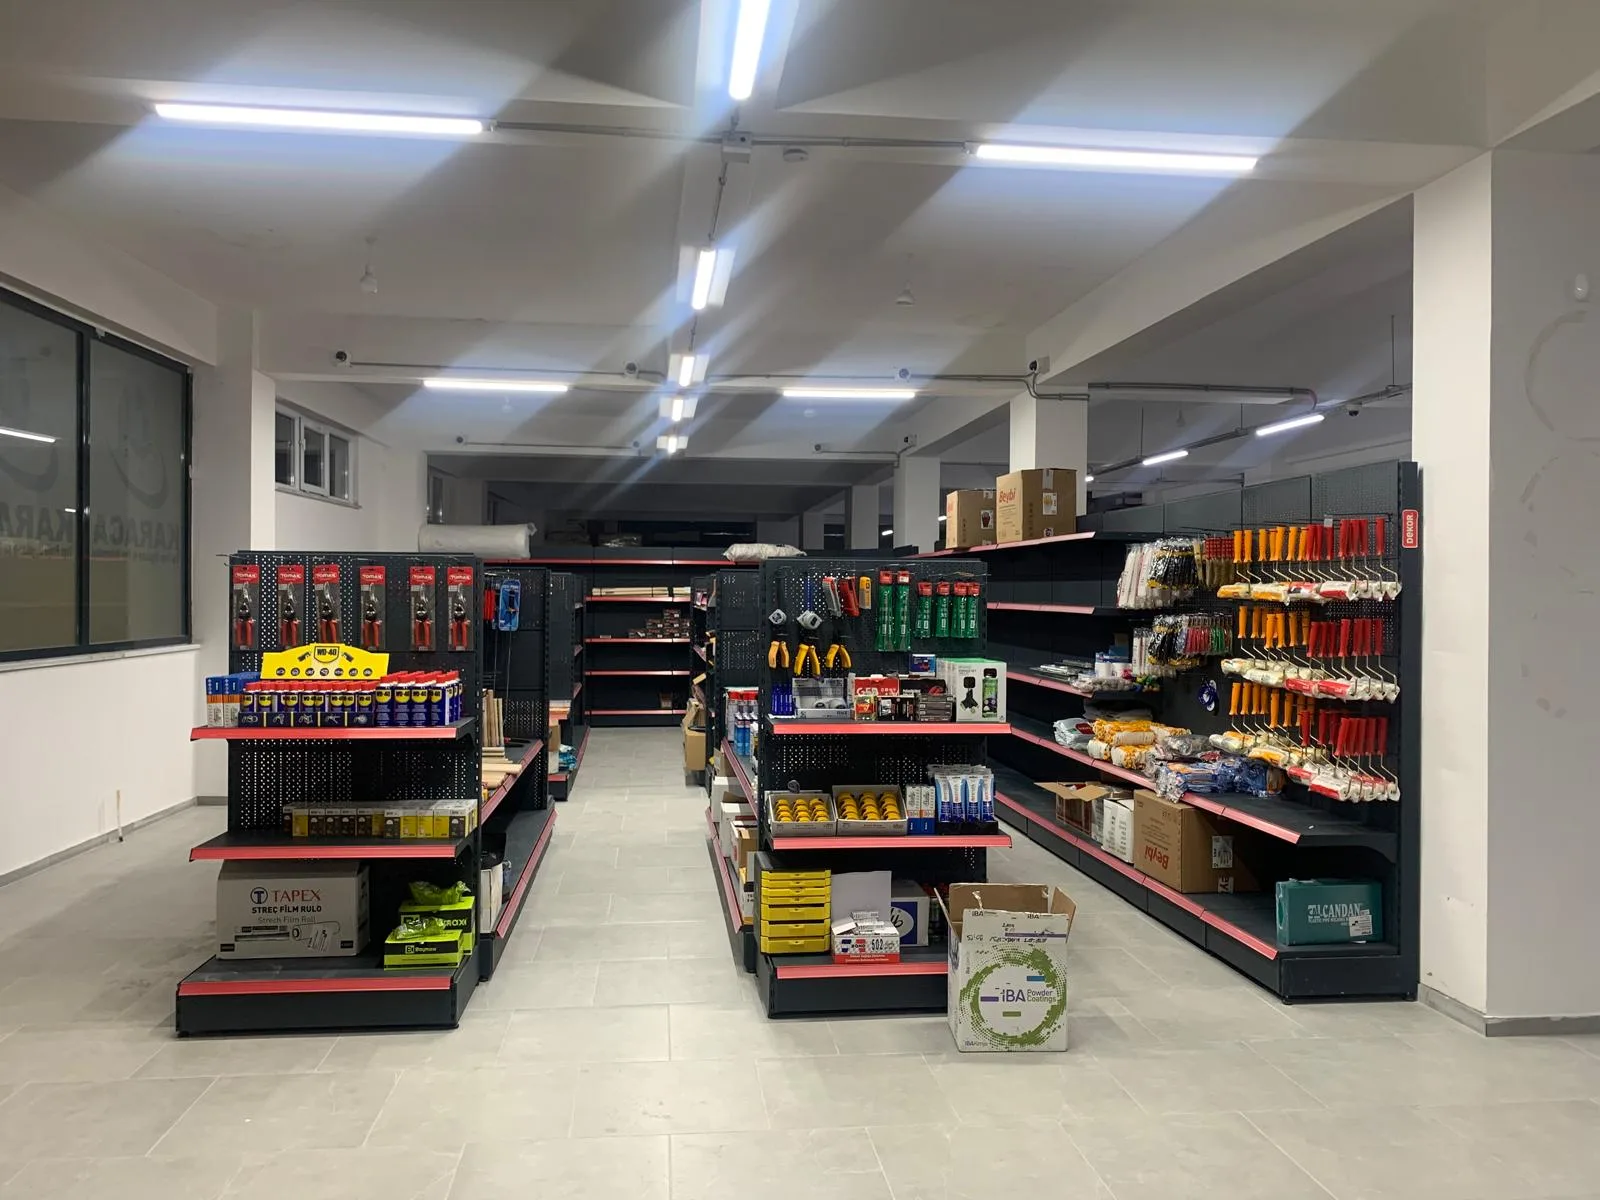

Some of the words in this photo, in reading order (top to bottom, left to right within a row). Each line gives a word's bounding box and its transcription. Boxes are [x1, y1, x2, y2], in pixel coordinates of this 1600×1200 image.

[317, 648, 337, 656] WD-40
[271, 889, 321, 902] TAPEX
[251, 906, 278, 914] STREÇ
[280, 904, 299, 913] FİLM
[1322, 903, 1361, 918] CANDAN
[871, 938, 884, 951] 502
[1002, 989, 1026, 1003] iBA
[1026, 989, 1054, 997] Powder
[1027, 996, 1057, 1004] Coatings
